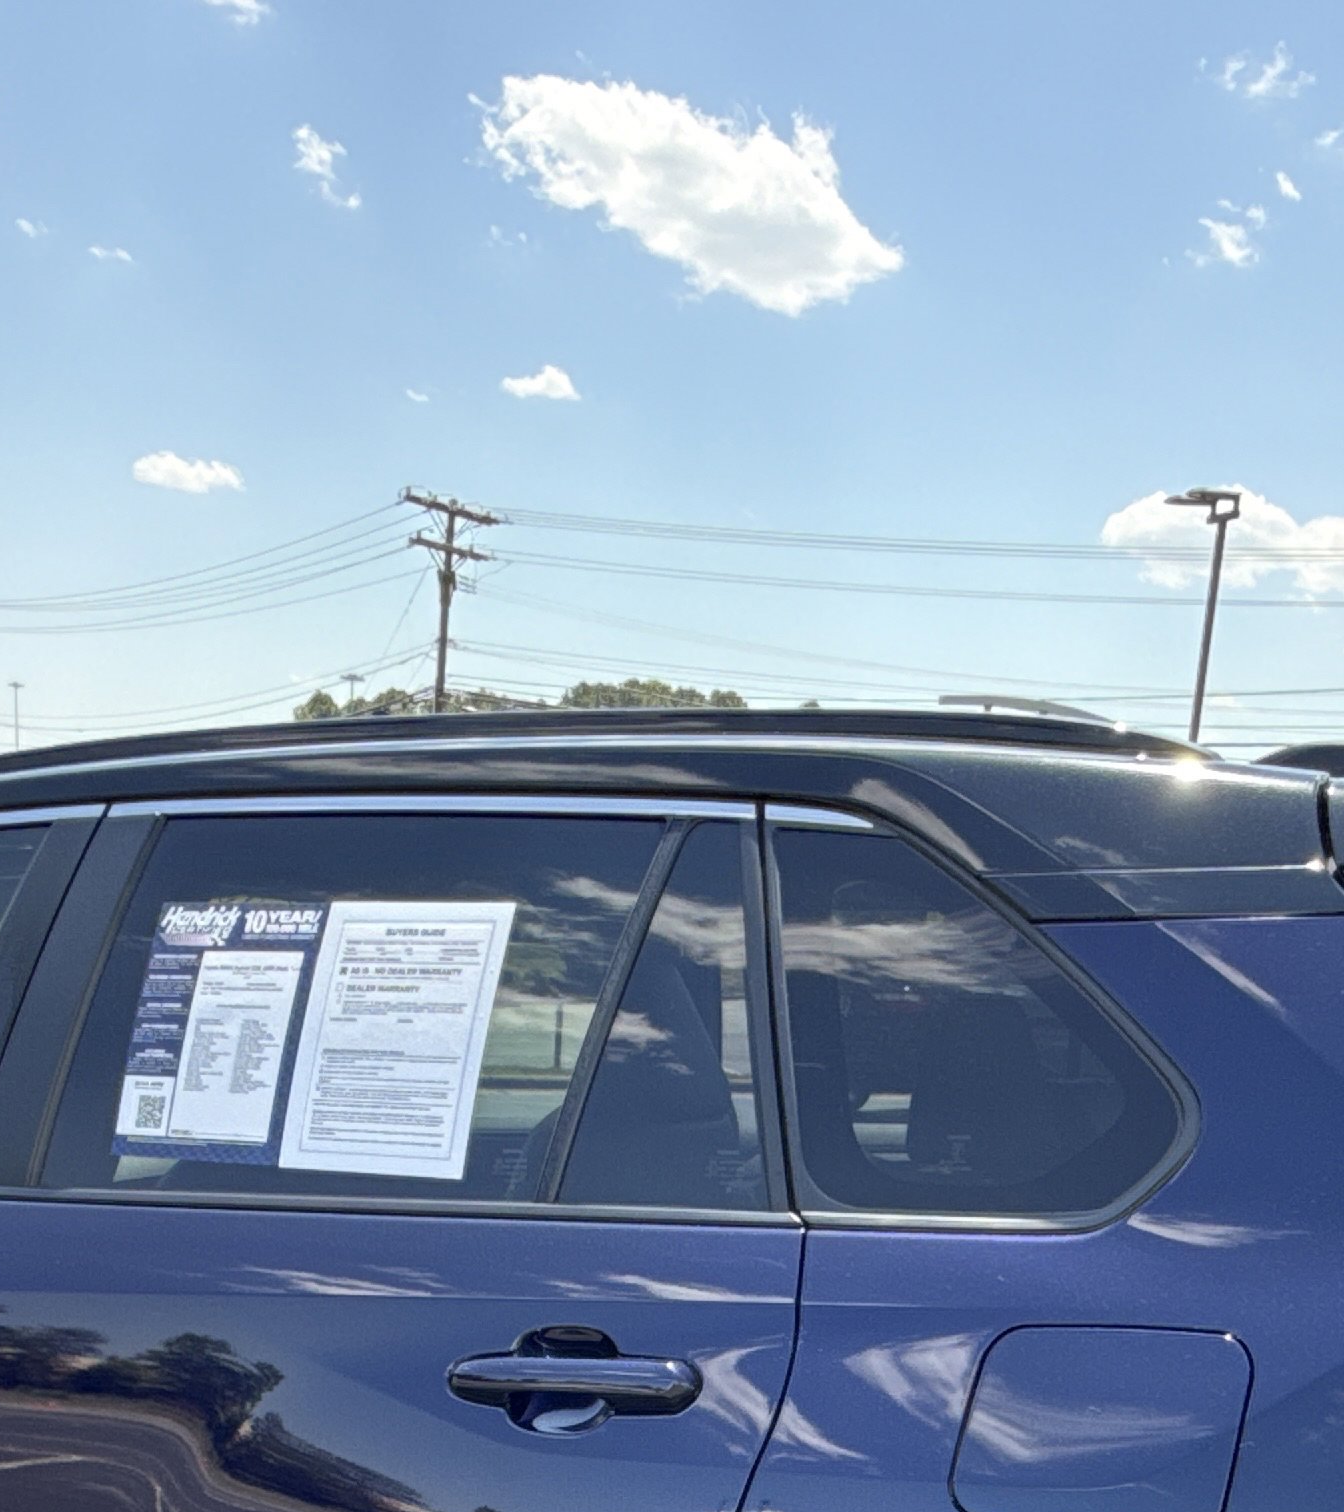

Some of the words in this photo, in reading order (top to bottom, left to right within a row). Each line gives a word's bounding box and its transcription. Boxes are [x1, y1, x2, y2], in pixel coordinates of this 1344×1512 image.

[160, 906, 242, 934] Hendrick
[244, 909, 267, 934] 10
[385, 928, 419, 937] BUYERS
[420, 928, 447, 937] GUIDE
